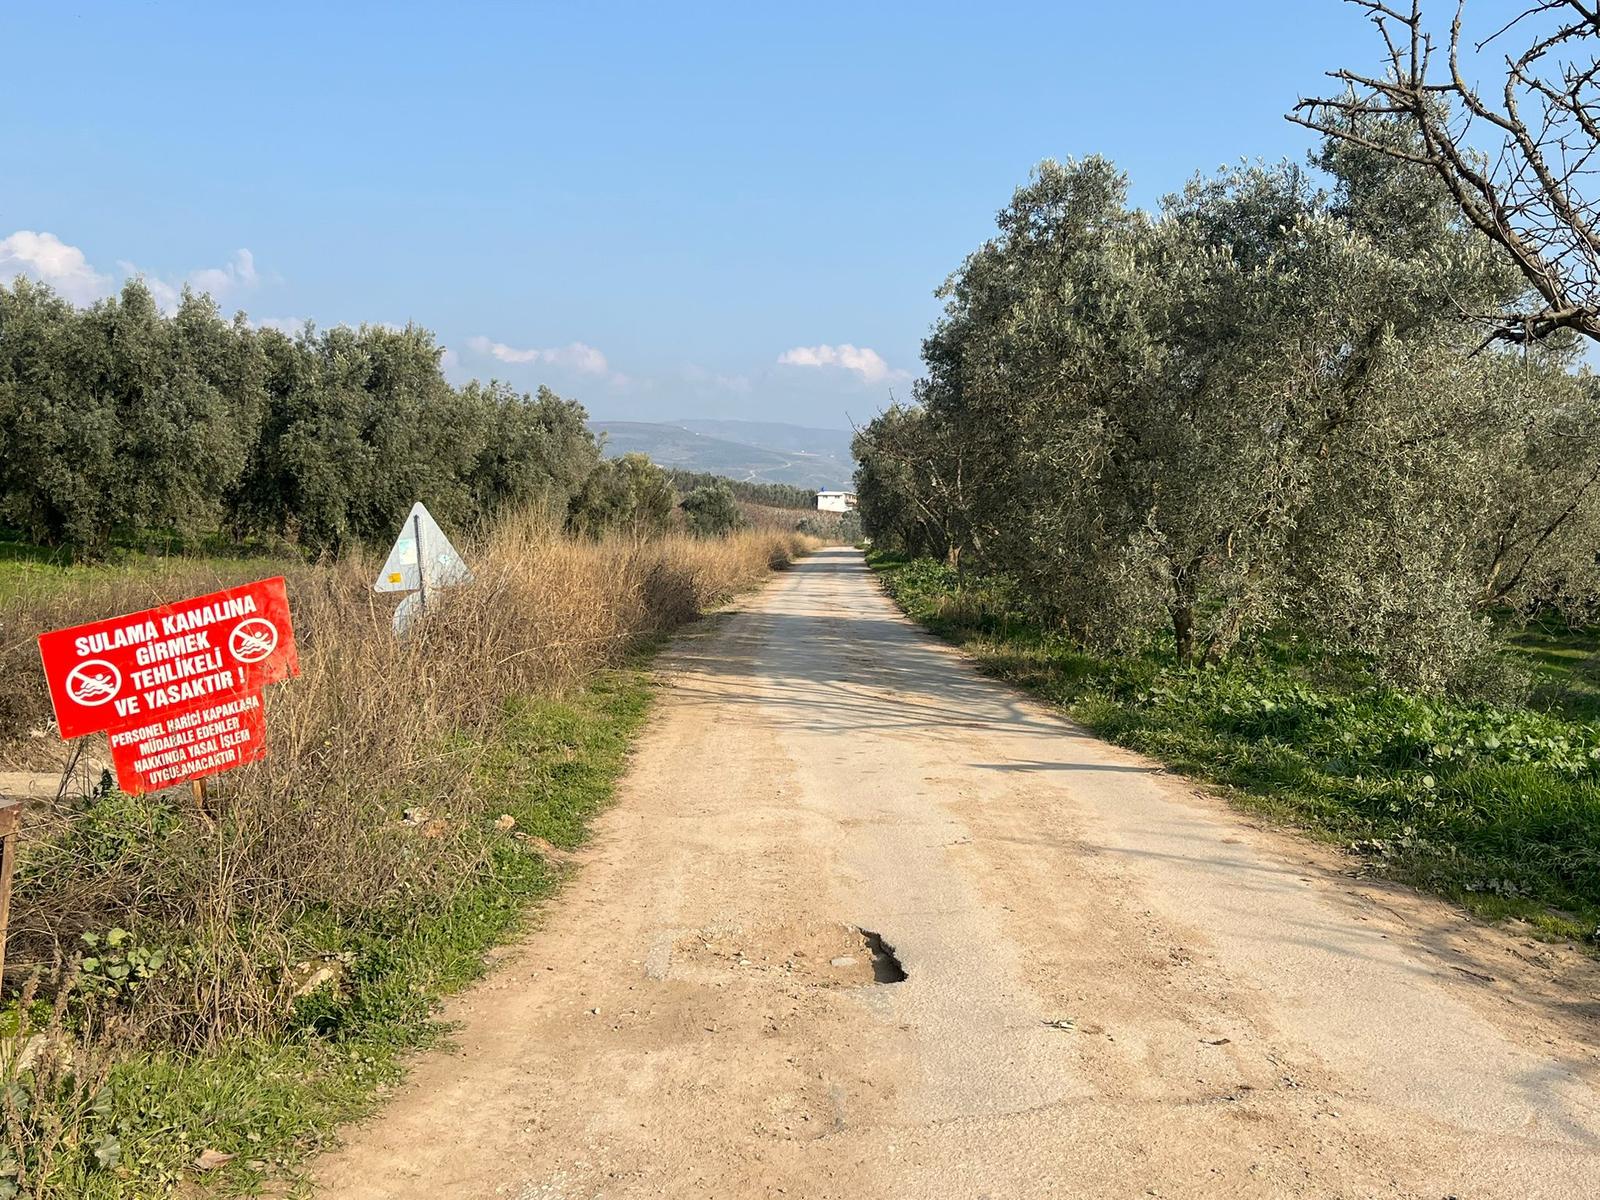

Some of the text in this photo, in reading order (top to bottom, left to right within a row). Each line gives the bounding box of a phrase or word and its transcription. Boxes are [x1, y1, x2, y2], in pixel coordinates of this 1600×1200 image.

[75, 595, 257, 656] SULAMA KANALINA
[130, 647, 223, 690] TEHLİKELİ
[136, 631, 210, 666] GİRMEK
[114, 667, 245, 717] VE YASAKTIR !
[111, 695, 259, 747] PERSONEL HARİCİ KAPAKLARA
[140, 717, 240, 756] MÜDAHALE EDENLER
[134, 729, 250, 773] HAKKINDA YASAL İŞLEM
[149, 750, 235, 784] UYGULANACAKTIR
